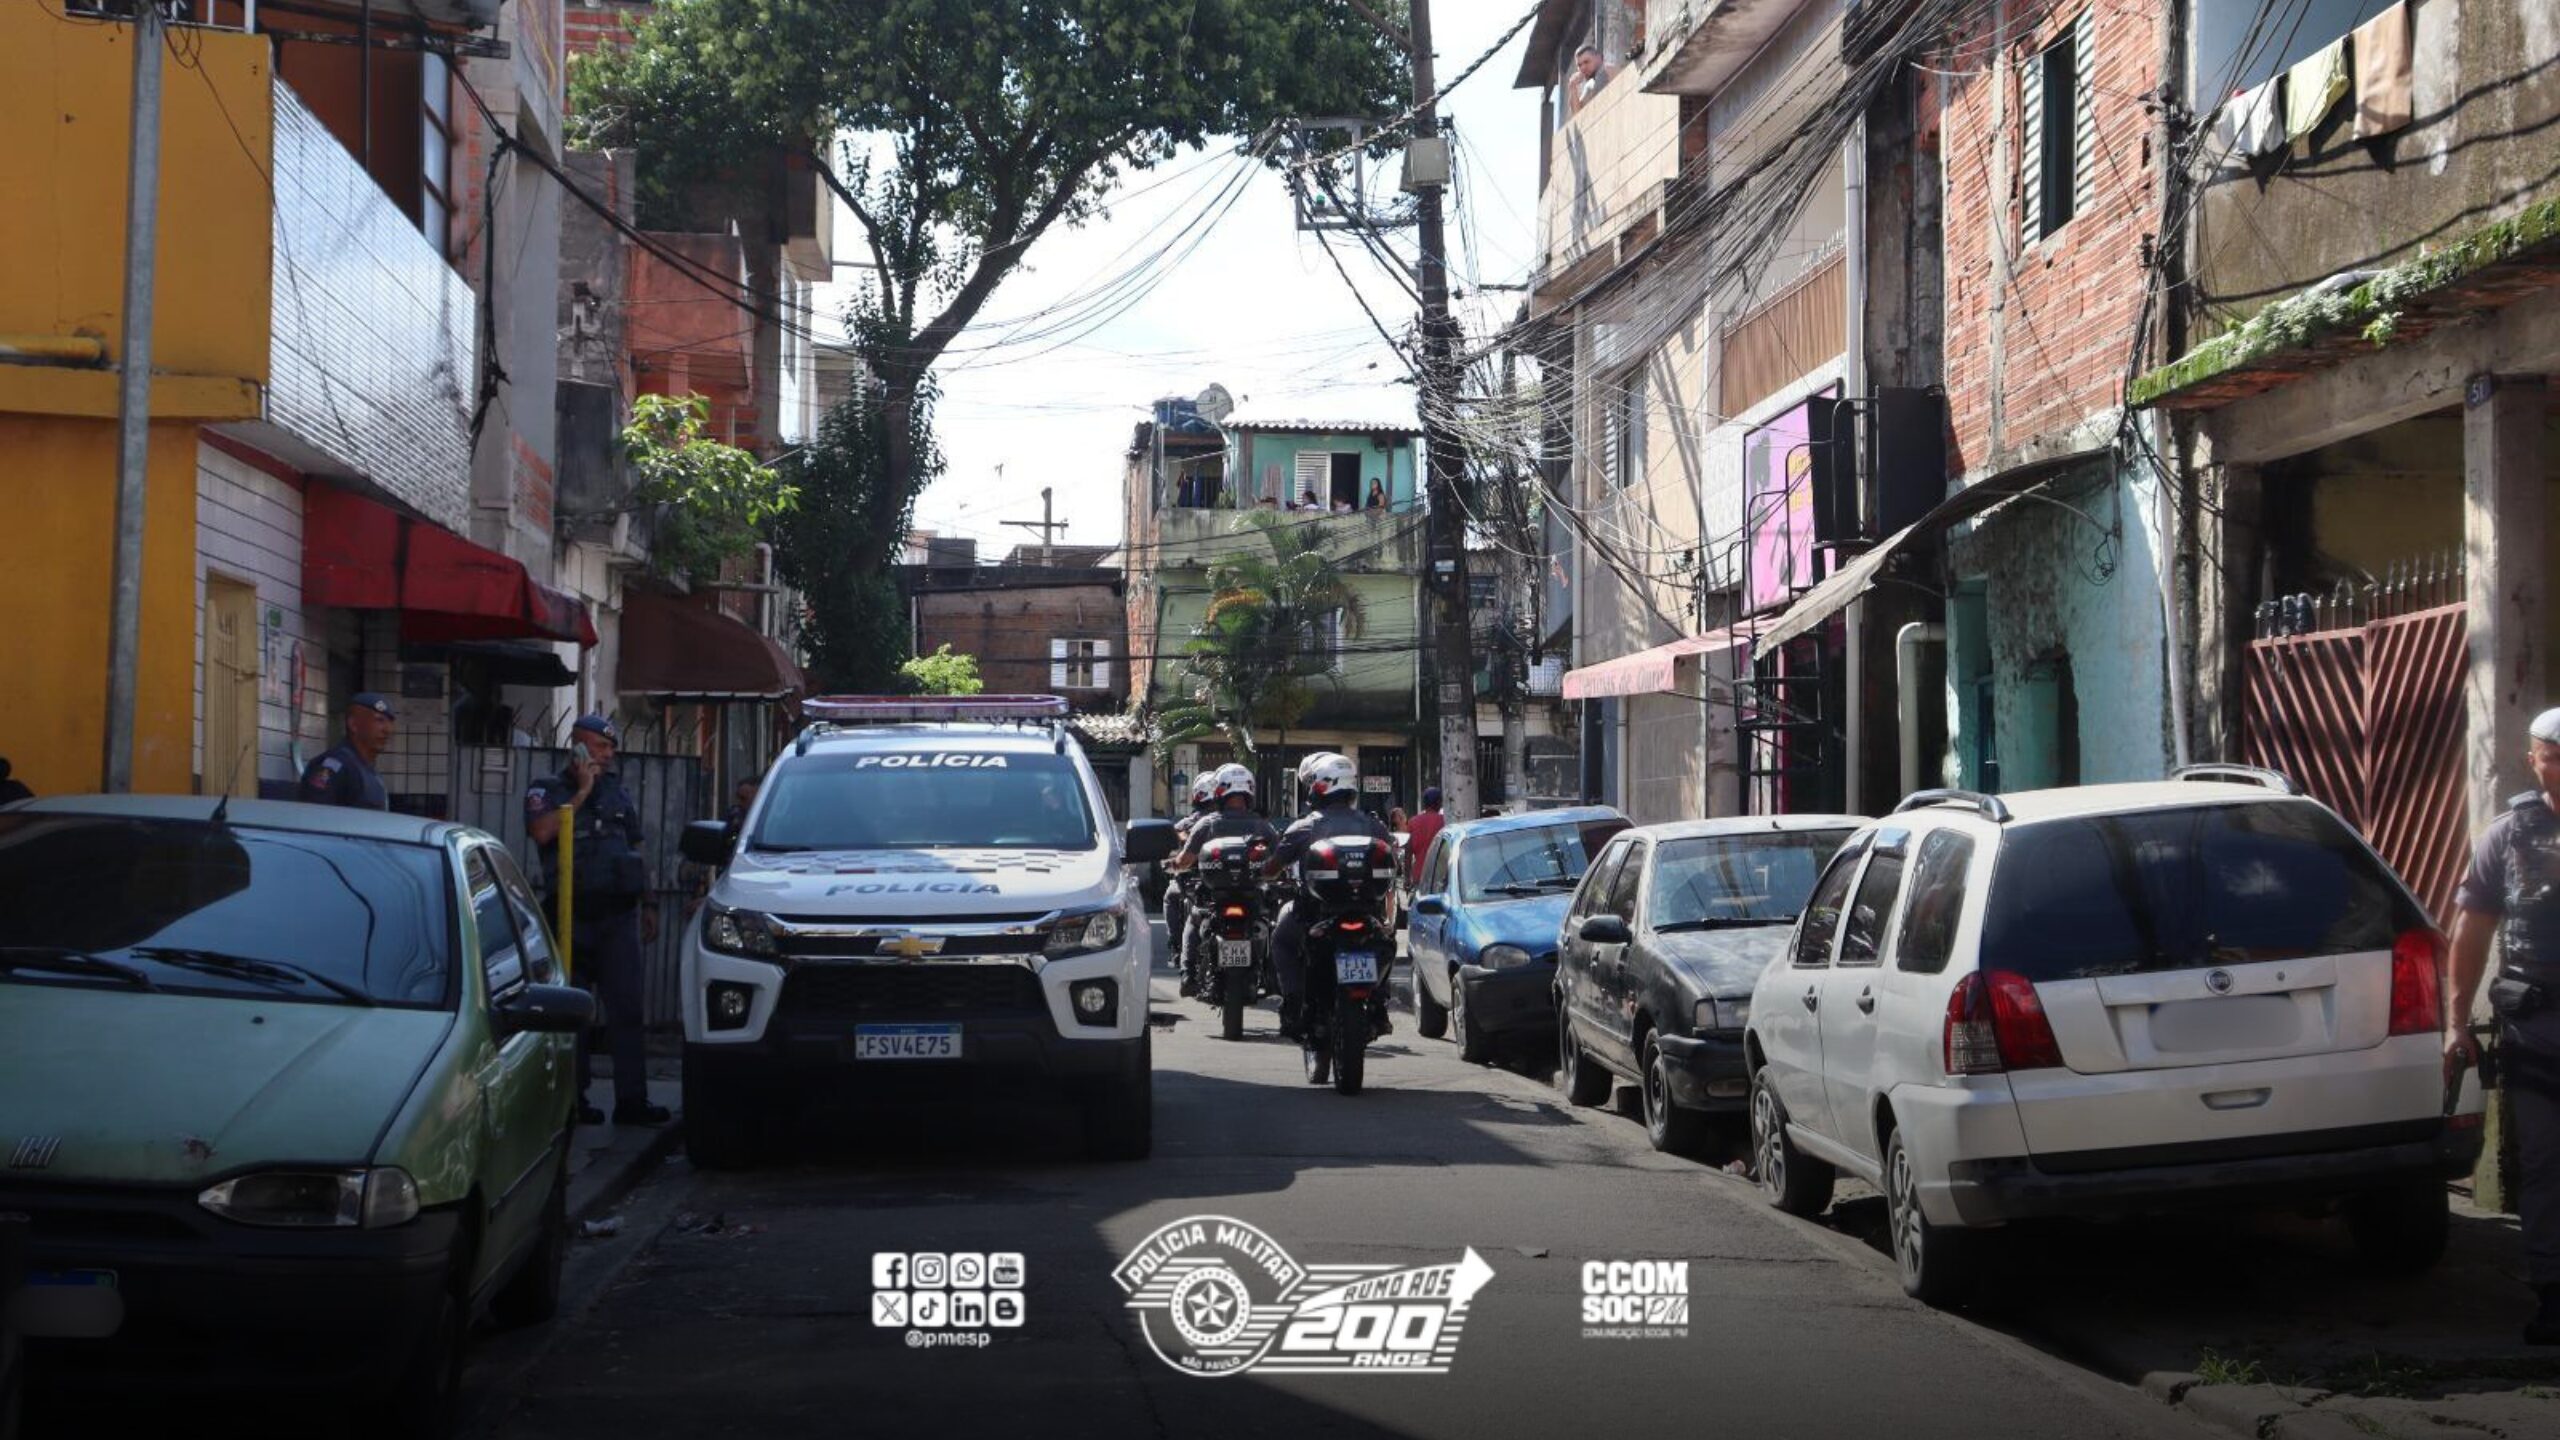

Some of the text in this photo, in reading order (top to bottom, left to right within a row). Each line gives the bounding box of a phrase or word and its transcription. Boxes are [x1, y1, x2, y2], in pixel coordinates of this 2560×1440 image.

[855, 753, 1007, 768] POLÍCIA
[825, 882, 1001, 896] POLÍCIA
[866, 1035, 951, 1055] FSV4E75
